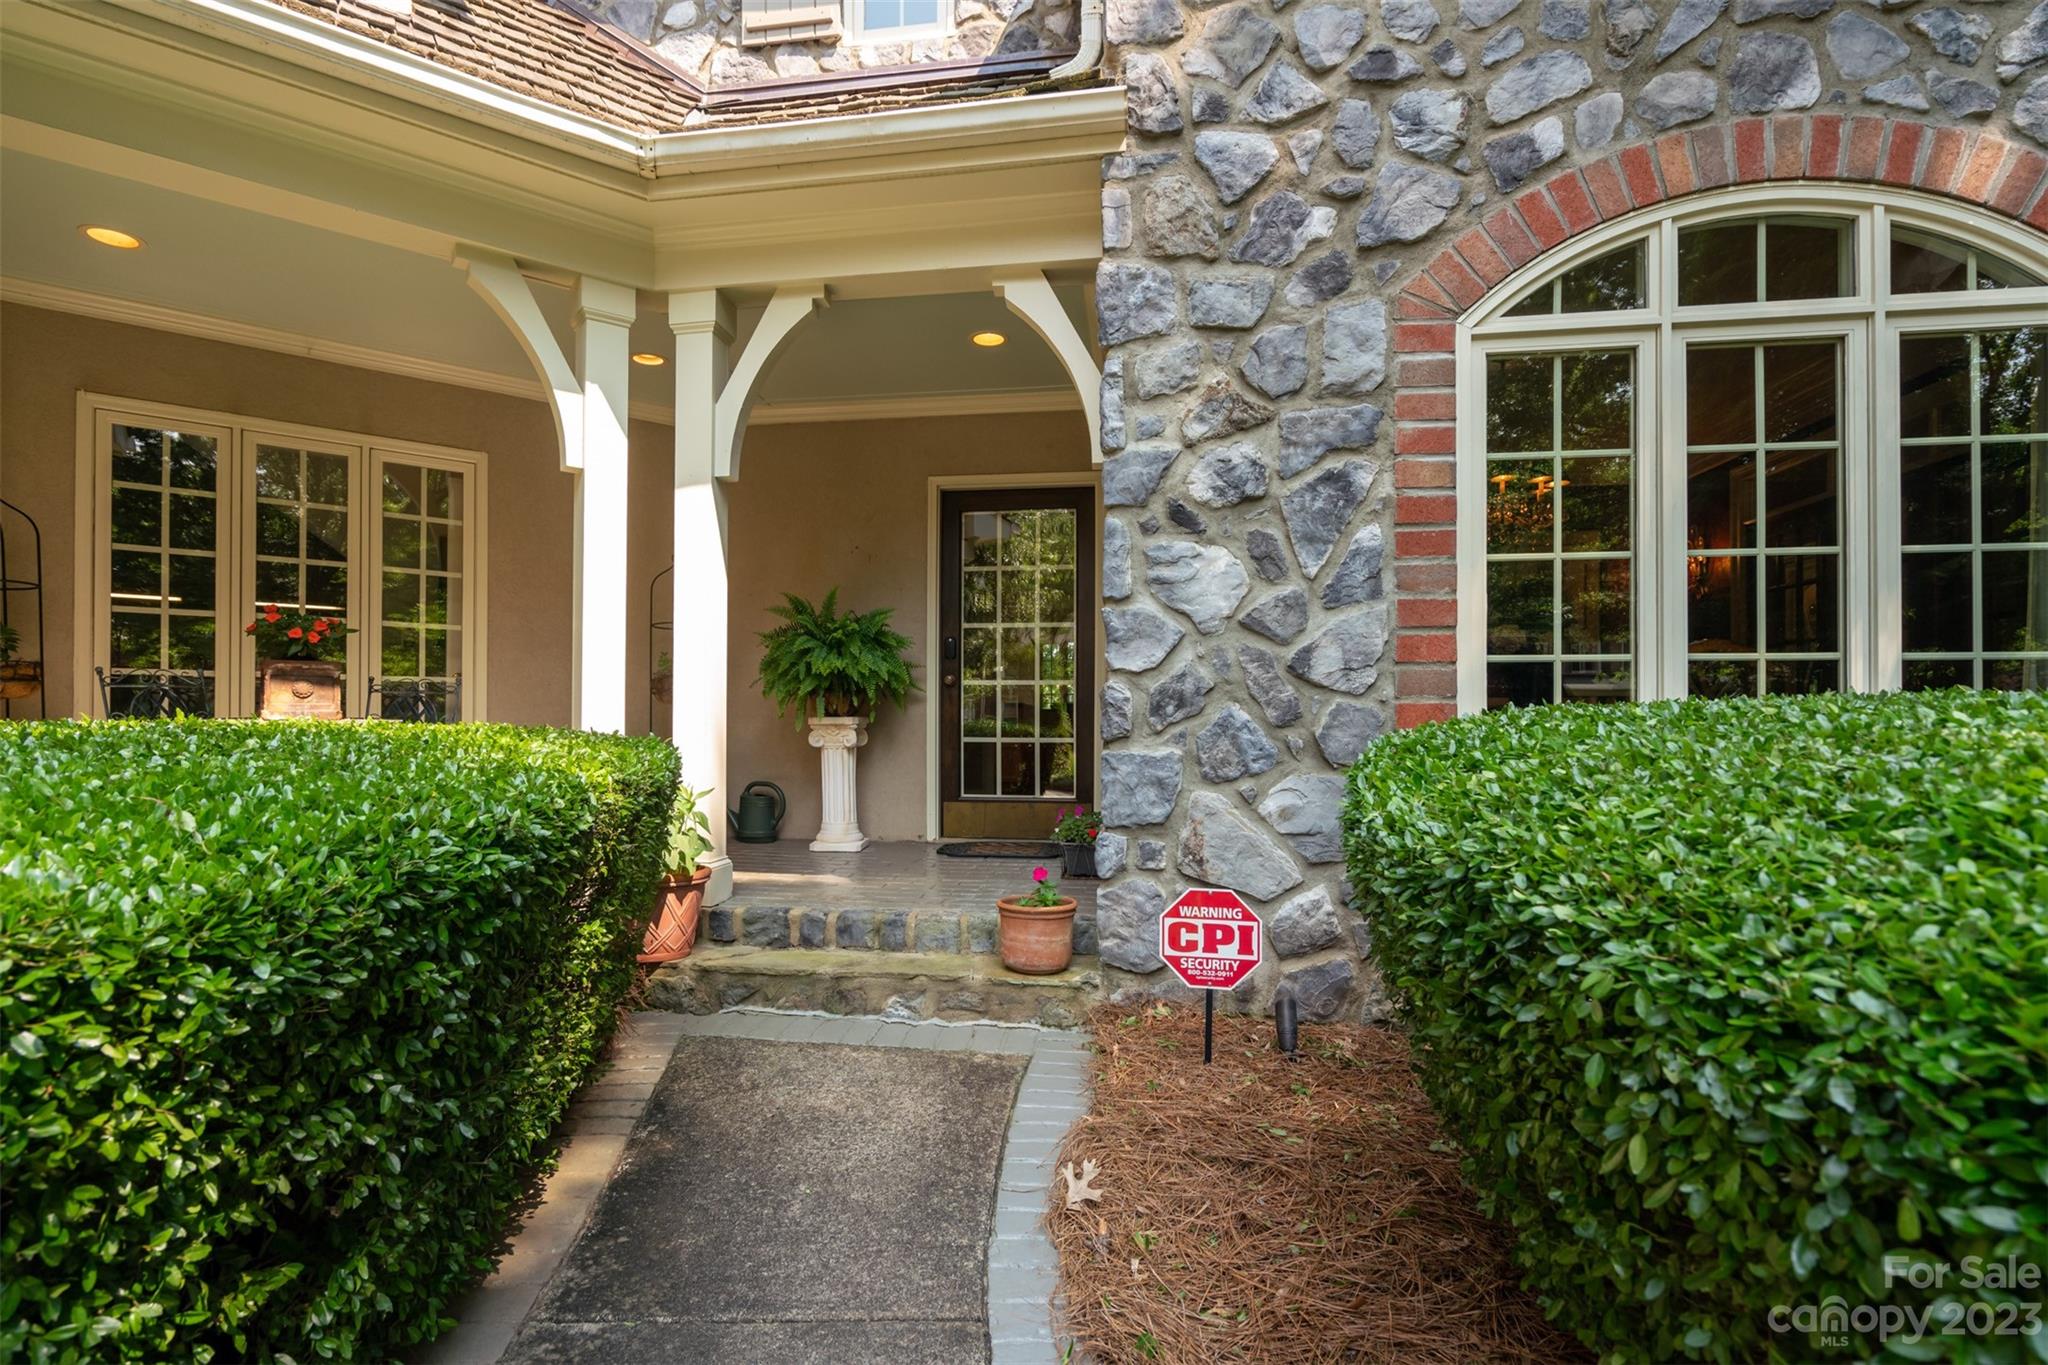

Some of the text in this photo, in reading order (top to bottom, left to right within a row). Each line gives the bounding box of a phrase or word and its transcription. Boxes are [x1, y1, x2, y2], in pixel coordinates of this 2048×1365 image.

[1179, 906, 1243, 919] WARNING
[1168, 922, 1254, 956] CPI
[1180, 958, 1240, 971] SECURITY
